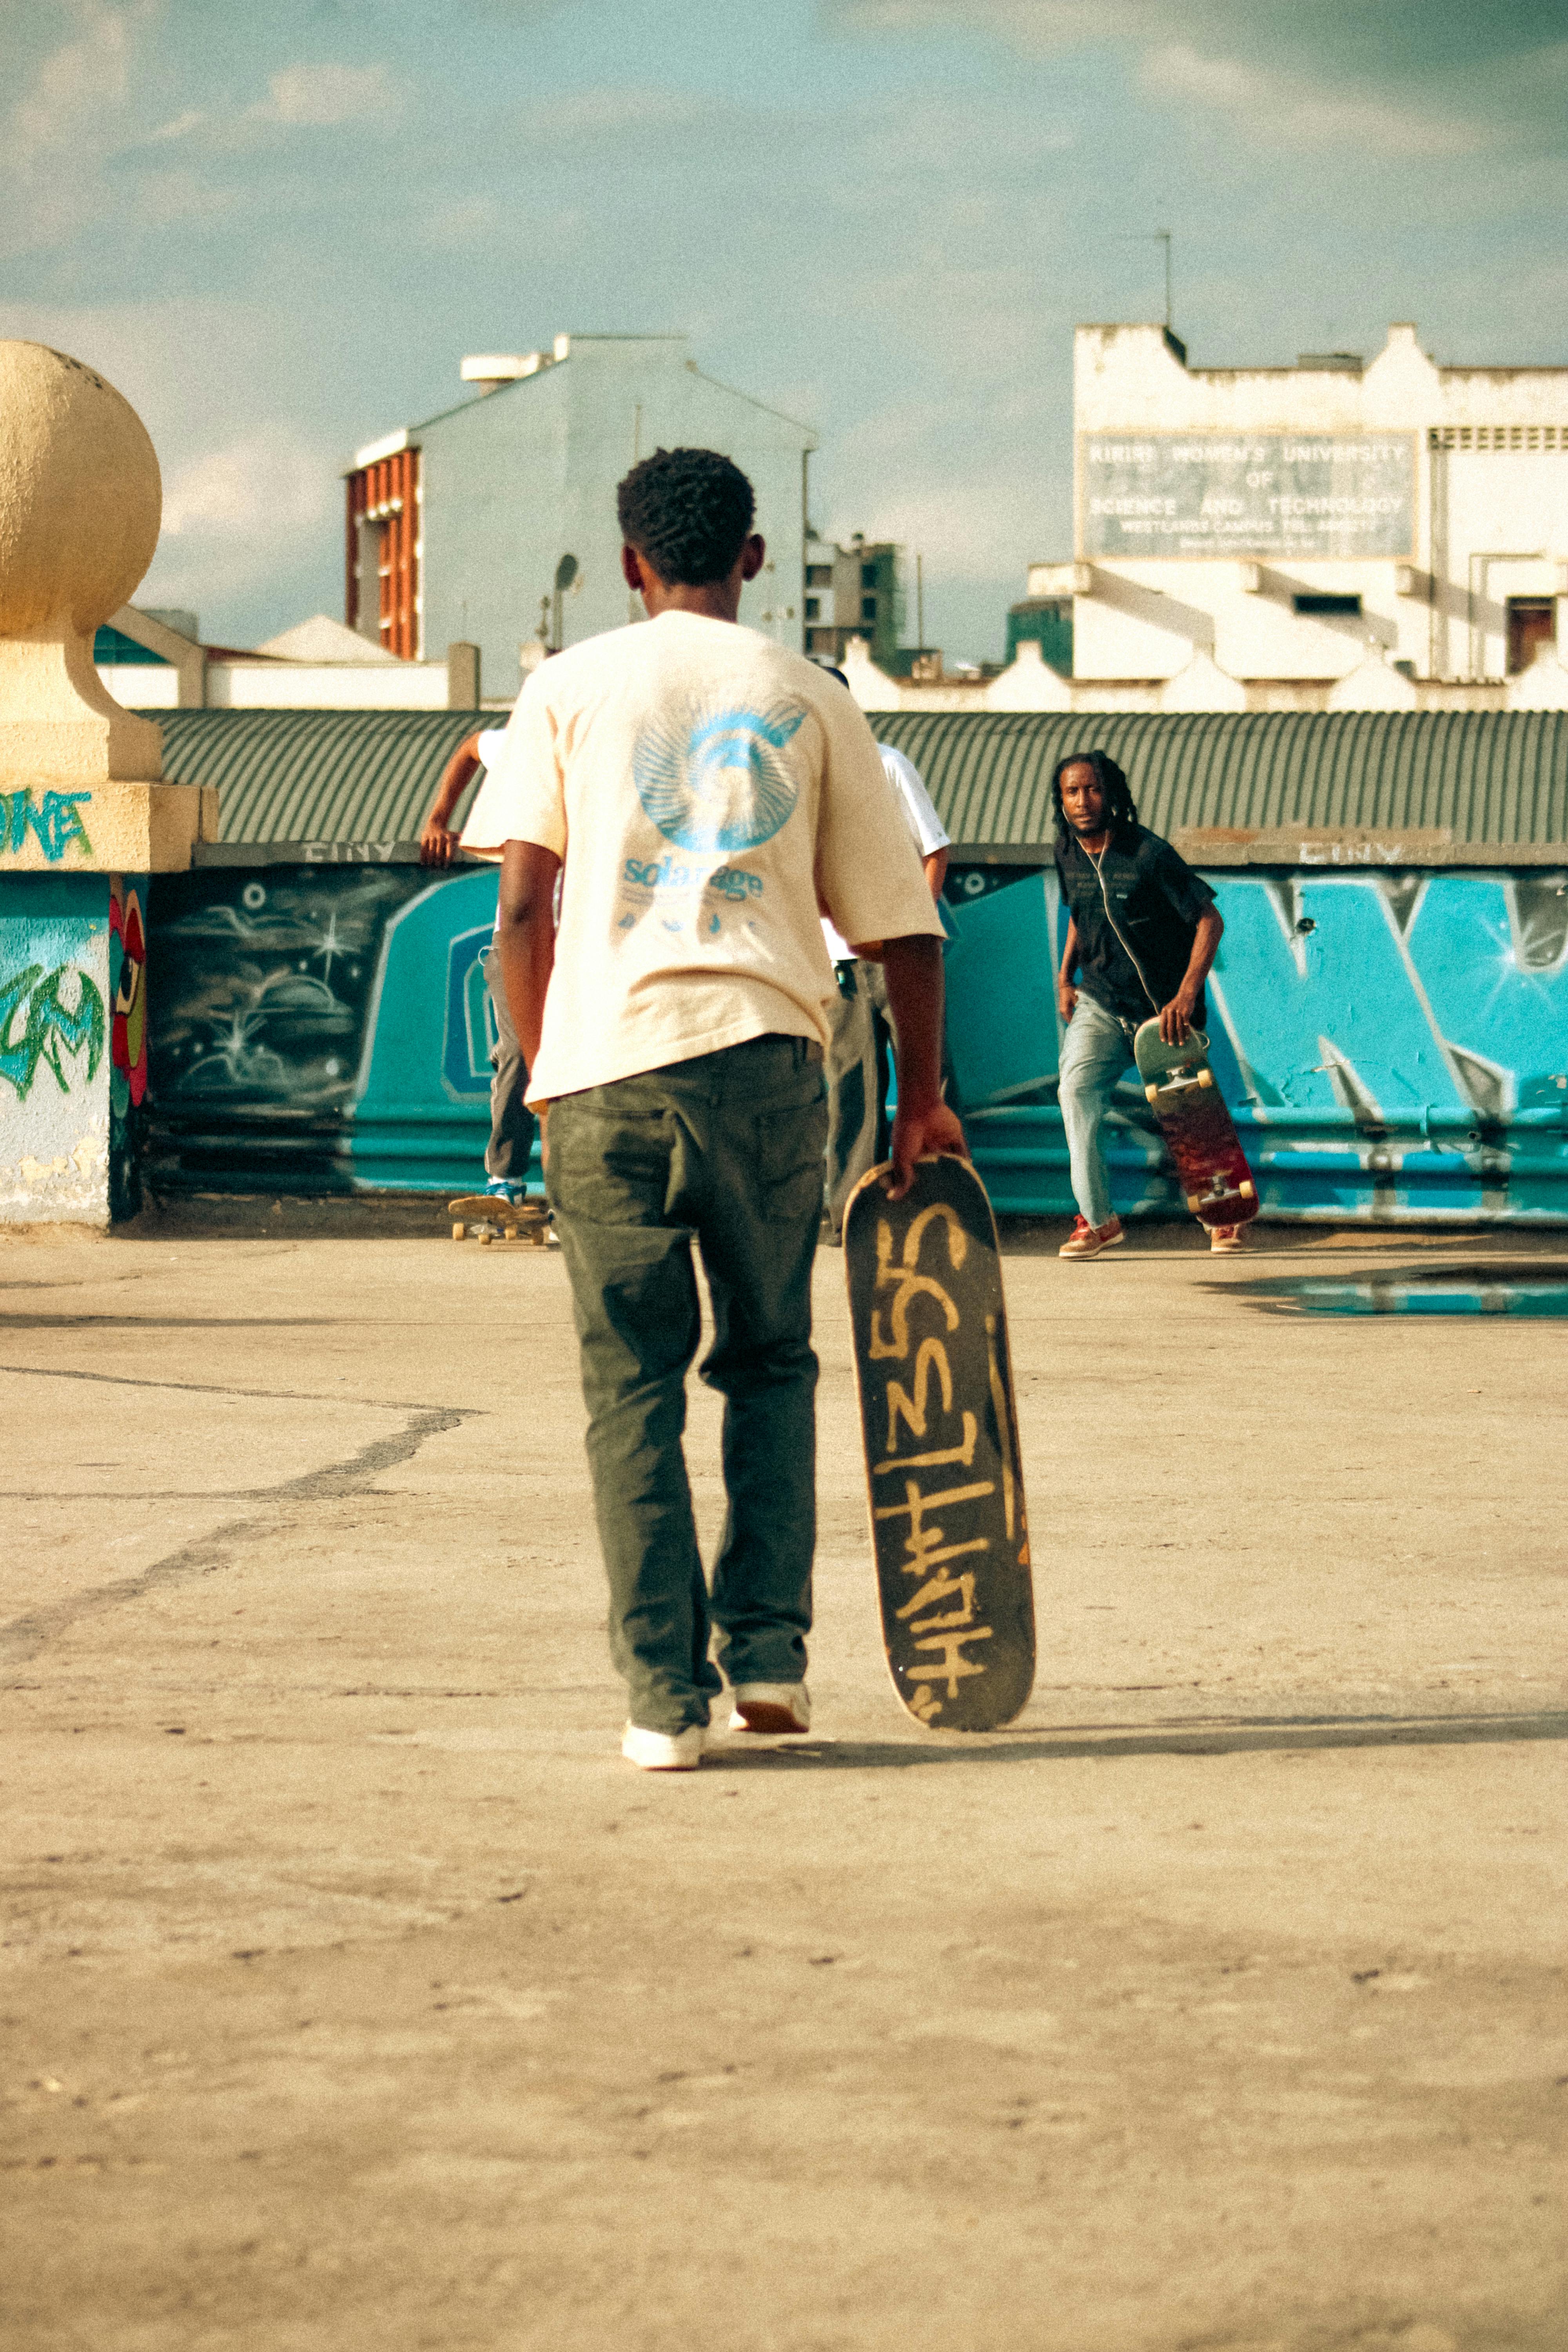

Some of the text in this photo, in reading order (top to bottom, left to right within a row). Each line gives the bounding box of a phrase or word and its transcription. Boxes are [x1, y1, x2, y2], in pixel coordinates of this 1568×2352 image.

[1283, 445, 1405, 462] UNIVERSITY
[1246, 471, 1273, 487] OF
[1090, 498, 1403, 515] SCIENCE AND TECHNOLOGY
